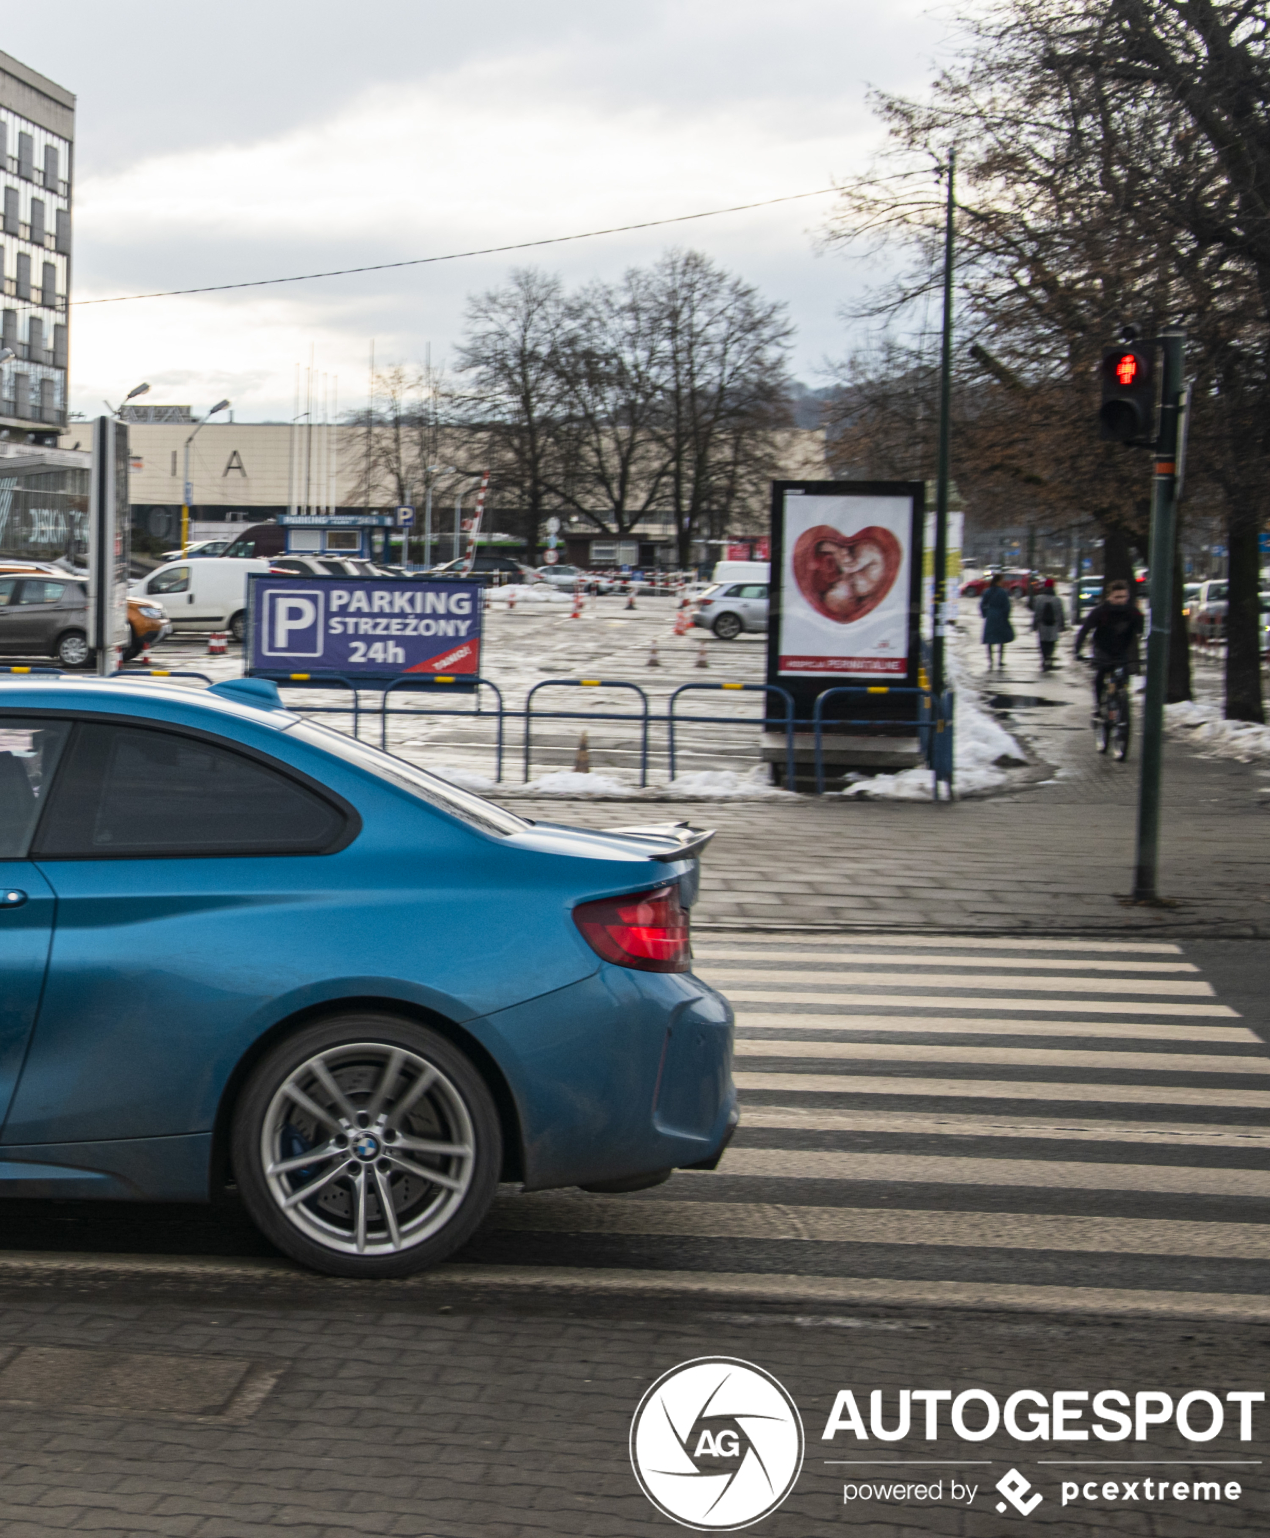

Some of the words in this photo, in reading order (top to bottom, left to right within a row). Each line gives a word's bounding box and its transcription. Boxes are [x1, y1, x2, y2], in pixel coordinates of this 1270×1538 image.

[397, 507, 413, 525] P
[331, 590, 472, 614] PARKING
[275, 598, 316, 648] P
[328, 615, 472, 637] STRZEŻONY
[348, 641, 406, 663] 24h
